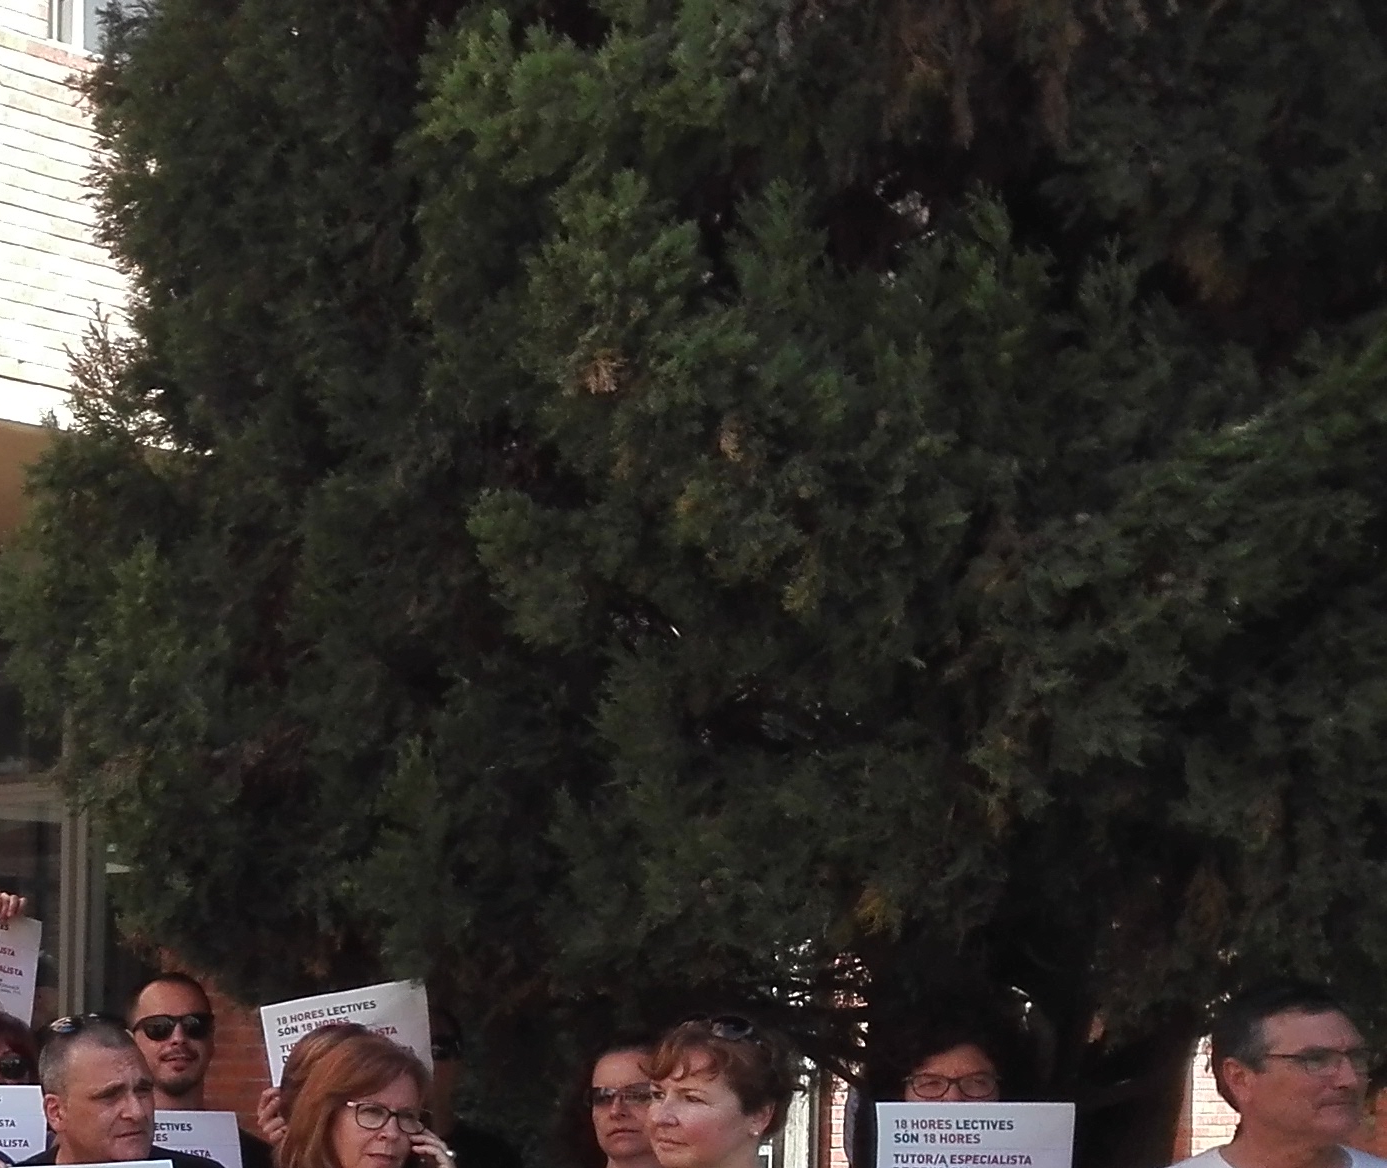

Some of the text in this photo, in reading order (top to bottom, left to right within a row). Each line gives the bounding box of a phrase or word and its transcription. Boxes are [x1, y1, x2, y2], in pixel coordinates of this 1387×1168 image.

[290, 1009, 324, 1023] HORES
[327, 1000, 376, 1017] LECTIVES
[895, 1120, 1014, 1130] 18 HORES LECTIVES
[924, 1134, 936, 1143] 18
[939, 1134, 980, 1143] HORES
[894, 1154, 1032, 1164] TUTOR/A ESPECIALISTA
